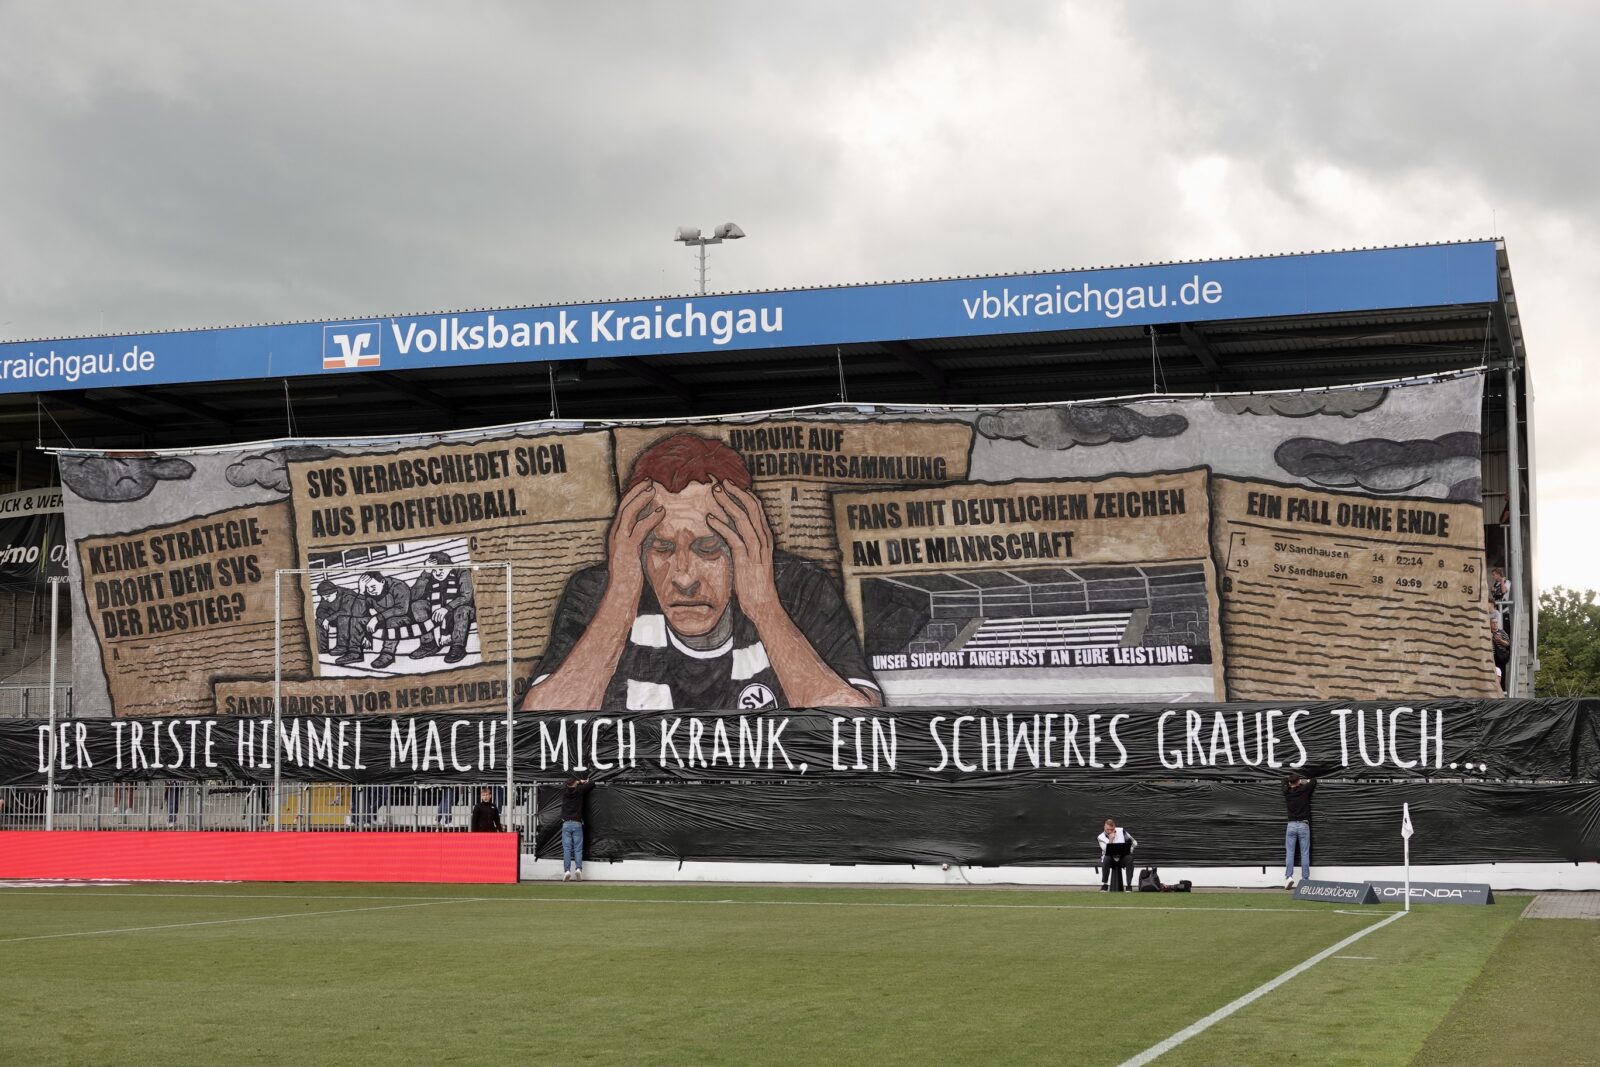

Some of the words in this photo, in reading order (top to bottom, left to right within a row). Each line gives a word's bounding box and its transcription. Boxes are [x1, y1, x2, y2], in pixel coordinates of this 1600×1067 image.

[963, 275, 1222, 319] vbkraichgau.de
[392, 310, 580, 354] Volksbank
[591, 303, 783, 344] Kraichgau
[0, 345, 155, 382] raichgau.de
[729, 425, 805, 451] UNRUHE
[808, 427, 844, 452] AUF
[306, 467, 347, 499] SVS
[349, 449, 511, 495] VERABSCHIEDET
[515, 443, 567, 477] SICH
[23, 496, 33, 511] &
[847, 502, 902, 530] FANS
[906, 499, 945, 527] MIT
[951, 493, 1088, 526] DEUTLICHEM
[1093, 488, 1186, 519] ZEICHEN
[1247, 492, 1282, 519] EIN
[1286, 497, 1331, 526] FALL
[1337, 502, 1392, 532] OHNE
[1397, 509, 1450, 538] ENDE
[311, 506, 355, 538] AUS
[88, 540, 149, 575] KEINE
[150, 517, 269, 565] STRATEGIE-
[470, 536, 478, 551] C
[852, 540, 882, 567] AN
[886, 538, 923, 565] DIE
[924, 531, 1074, 563] MANNSCHAFT
[1241, 537, 1246, 546] 1
[1274, 542, 1287, 552] SV
[1289, 543, 1349, 559] Sandhausen
[1373, 553, 1384, 563] 14
[1396, 555, 1423, 567] 22:14
[1438, 560, 1445, 568] 8
[1463, 564, 1475, 573] 26
[94, 571, 165, 610] DROHT
[169, 562, 215, 597] DEM
[217, 554, 262, 587] SVS
[1237, 559, 1249, 568] 19
[1274, 563, 1287, 573] SV
[1288, 565, 1348, 580] Sandhausen
[1372, 576, 1384, 585] 38
[1396, 578, 1422, 588] 49:69
[1433, 581, 1448, 589] -20
[1461, 585, 1473, 595] 35
[102, 606, 144, 639] DER
[147, 592, 246, 634] ABSTIEG?
[113, 648, 120, 661] A
[872, 654, 907, 670] UNSER
[910, 651, 965, 667] SUPPORT
[969, 649, 1046, 666] ANGEPASST
[1050, 650, 1070, 665] AN
[1074, 648, 1110, 665] EURE
[1113, 645, 1194, 665] LEISTUNG:
[350, 691, 391, 713] VOR
[38, 722, 93, 773] DER
[111, 720, 218, 770] TRISTE
[237, 717, 366, 770] HIMMEL
[539, 718, 636, 771] MICH
[659, 715, 808, 775] KRANK,
[832, 716, 897, 772] EIN
[929, 712, 1130, 772] SCHWERES
[1157, 709, 1310, 769] GRAUES
